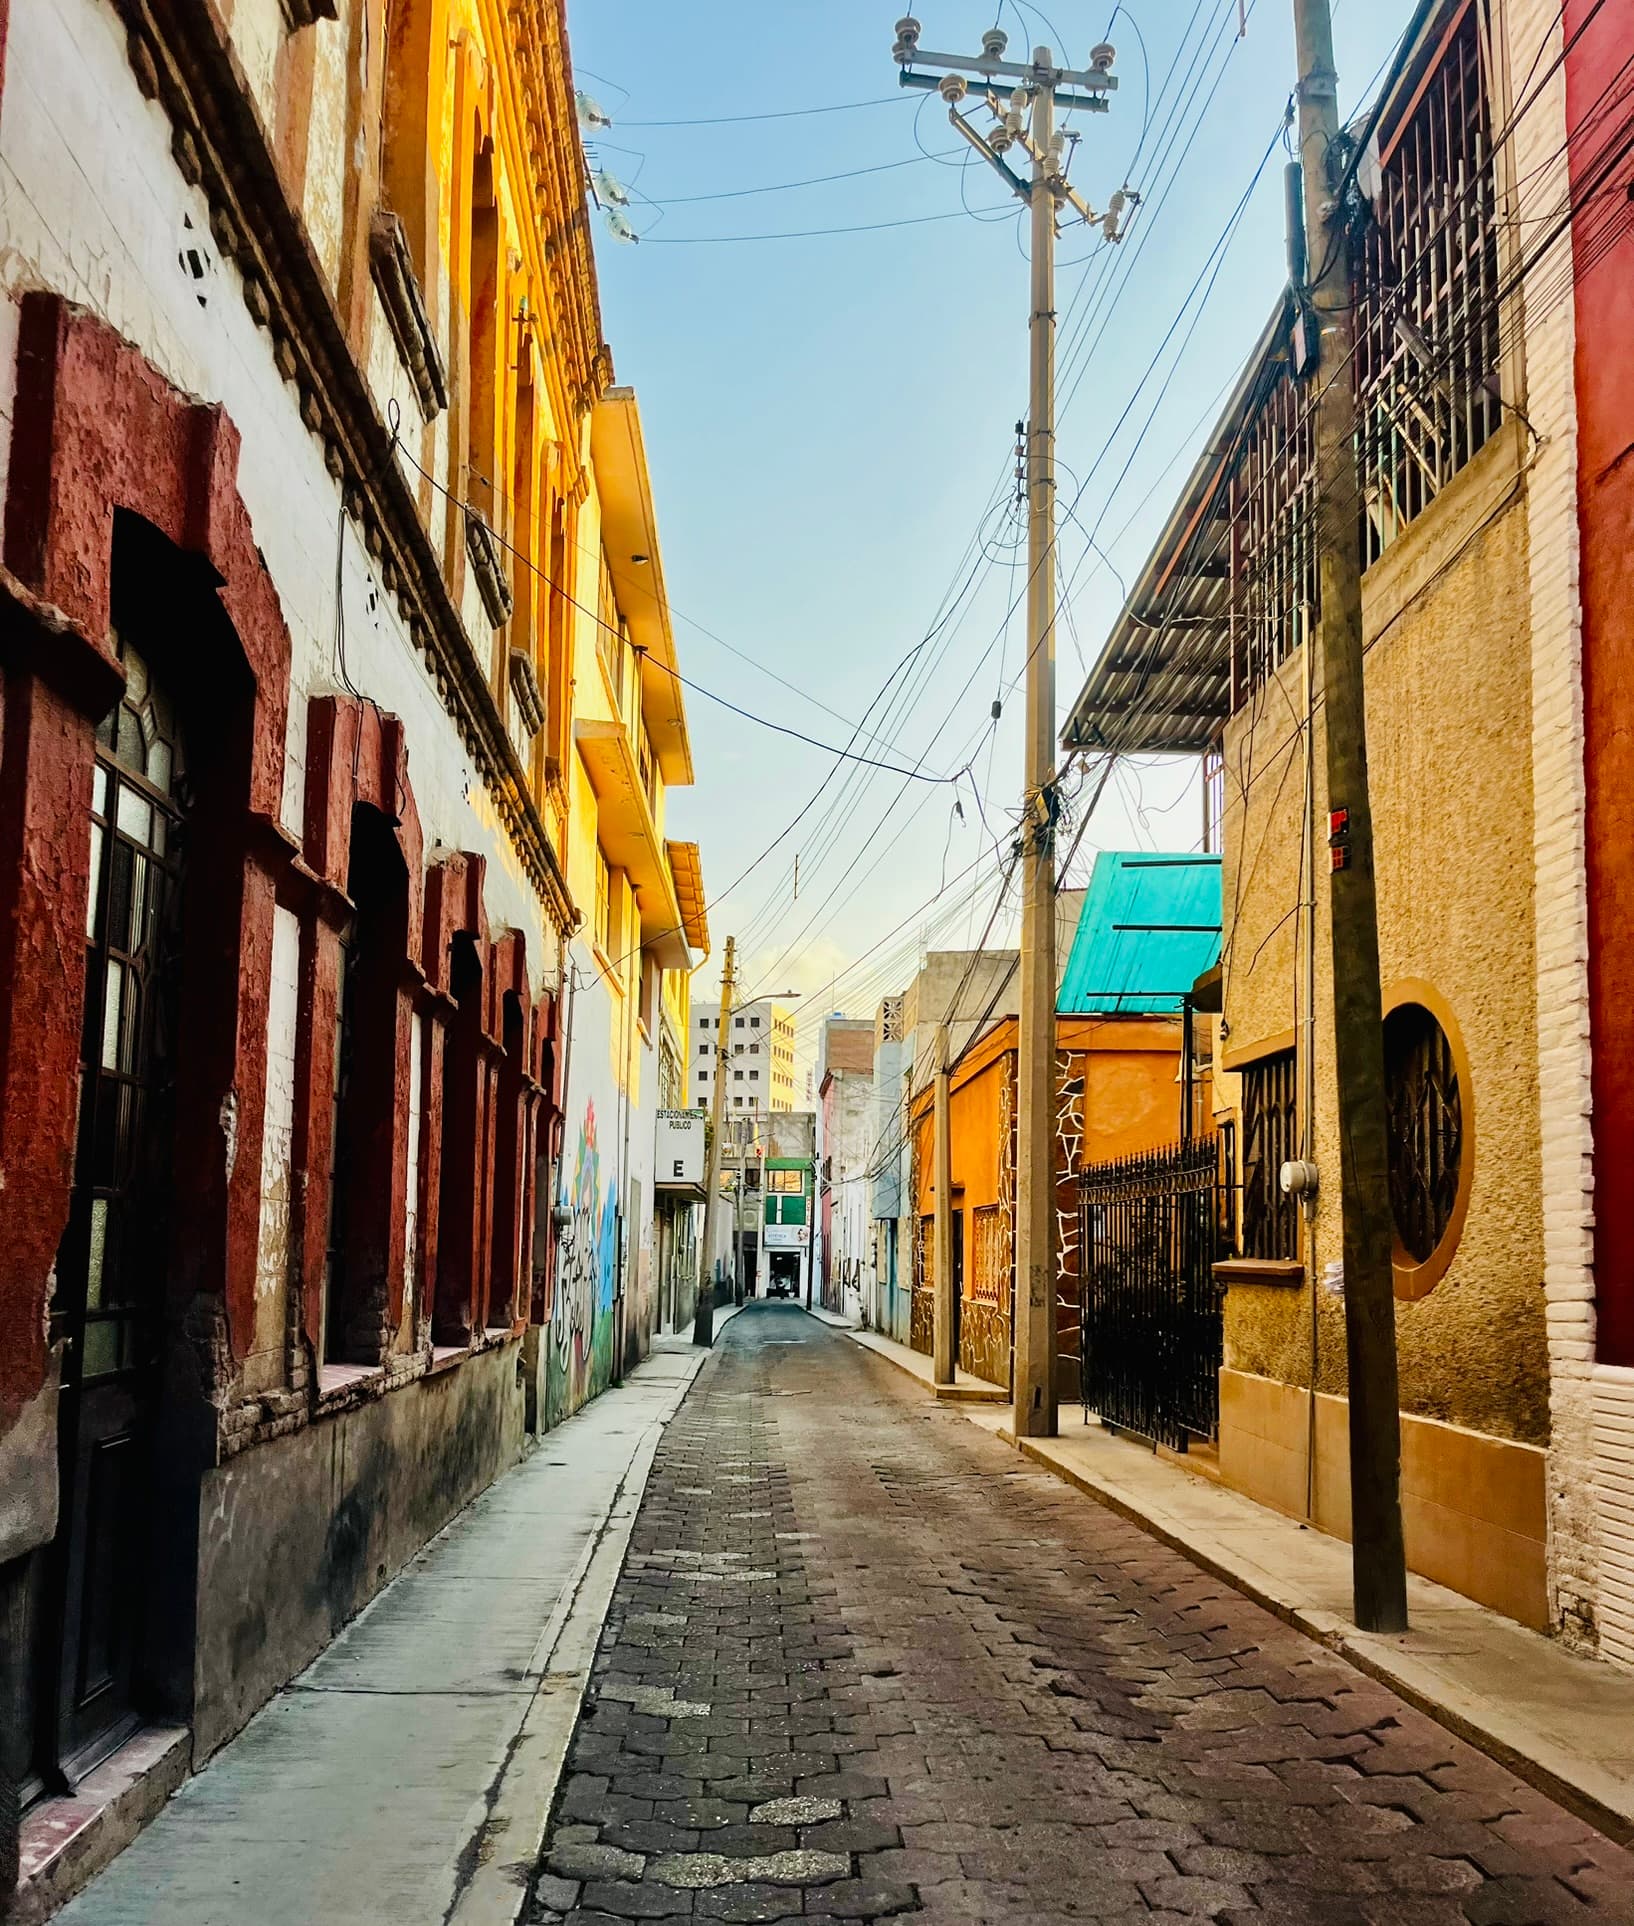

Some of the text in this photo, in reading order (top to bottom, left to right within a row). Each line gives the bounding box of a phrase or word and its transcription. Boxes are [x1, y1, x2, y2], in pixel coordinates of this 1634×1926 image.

[657, 1110, 703, 1119] ESTACIONAMIEN
[669, 1120, 692, 1129] PUBLICO
[673, 1160, 684, 1177] E
